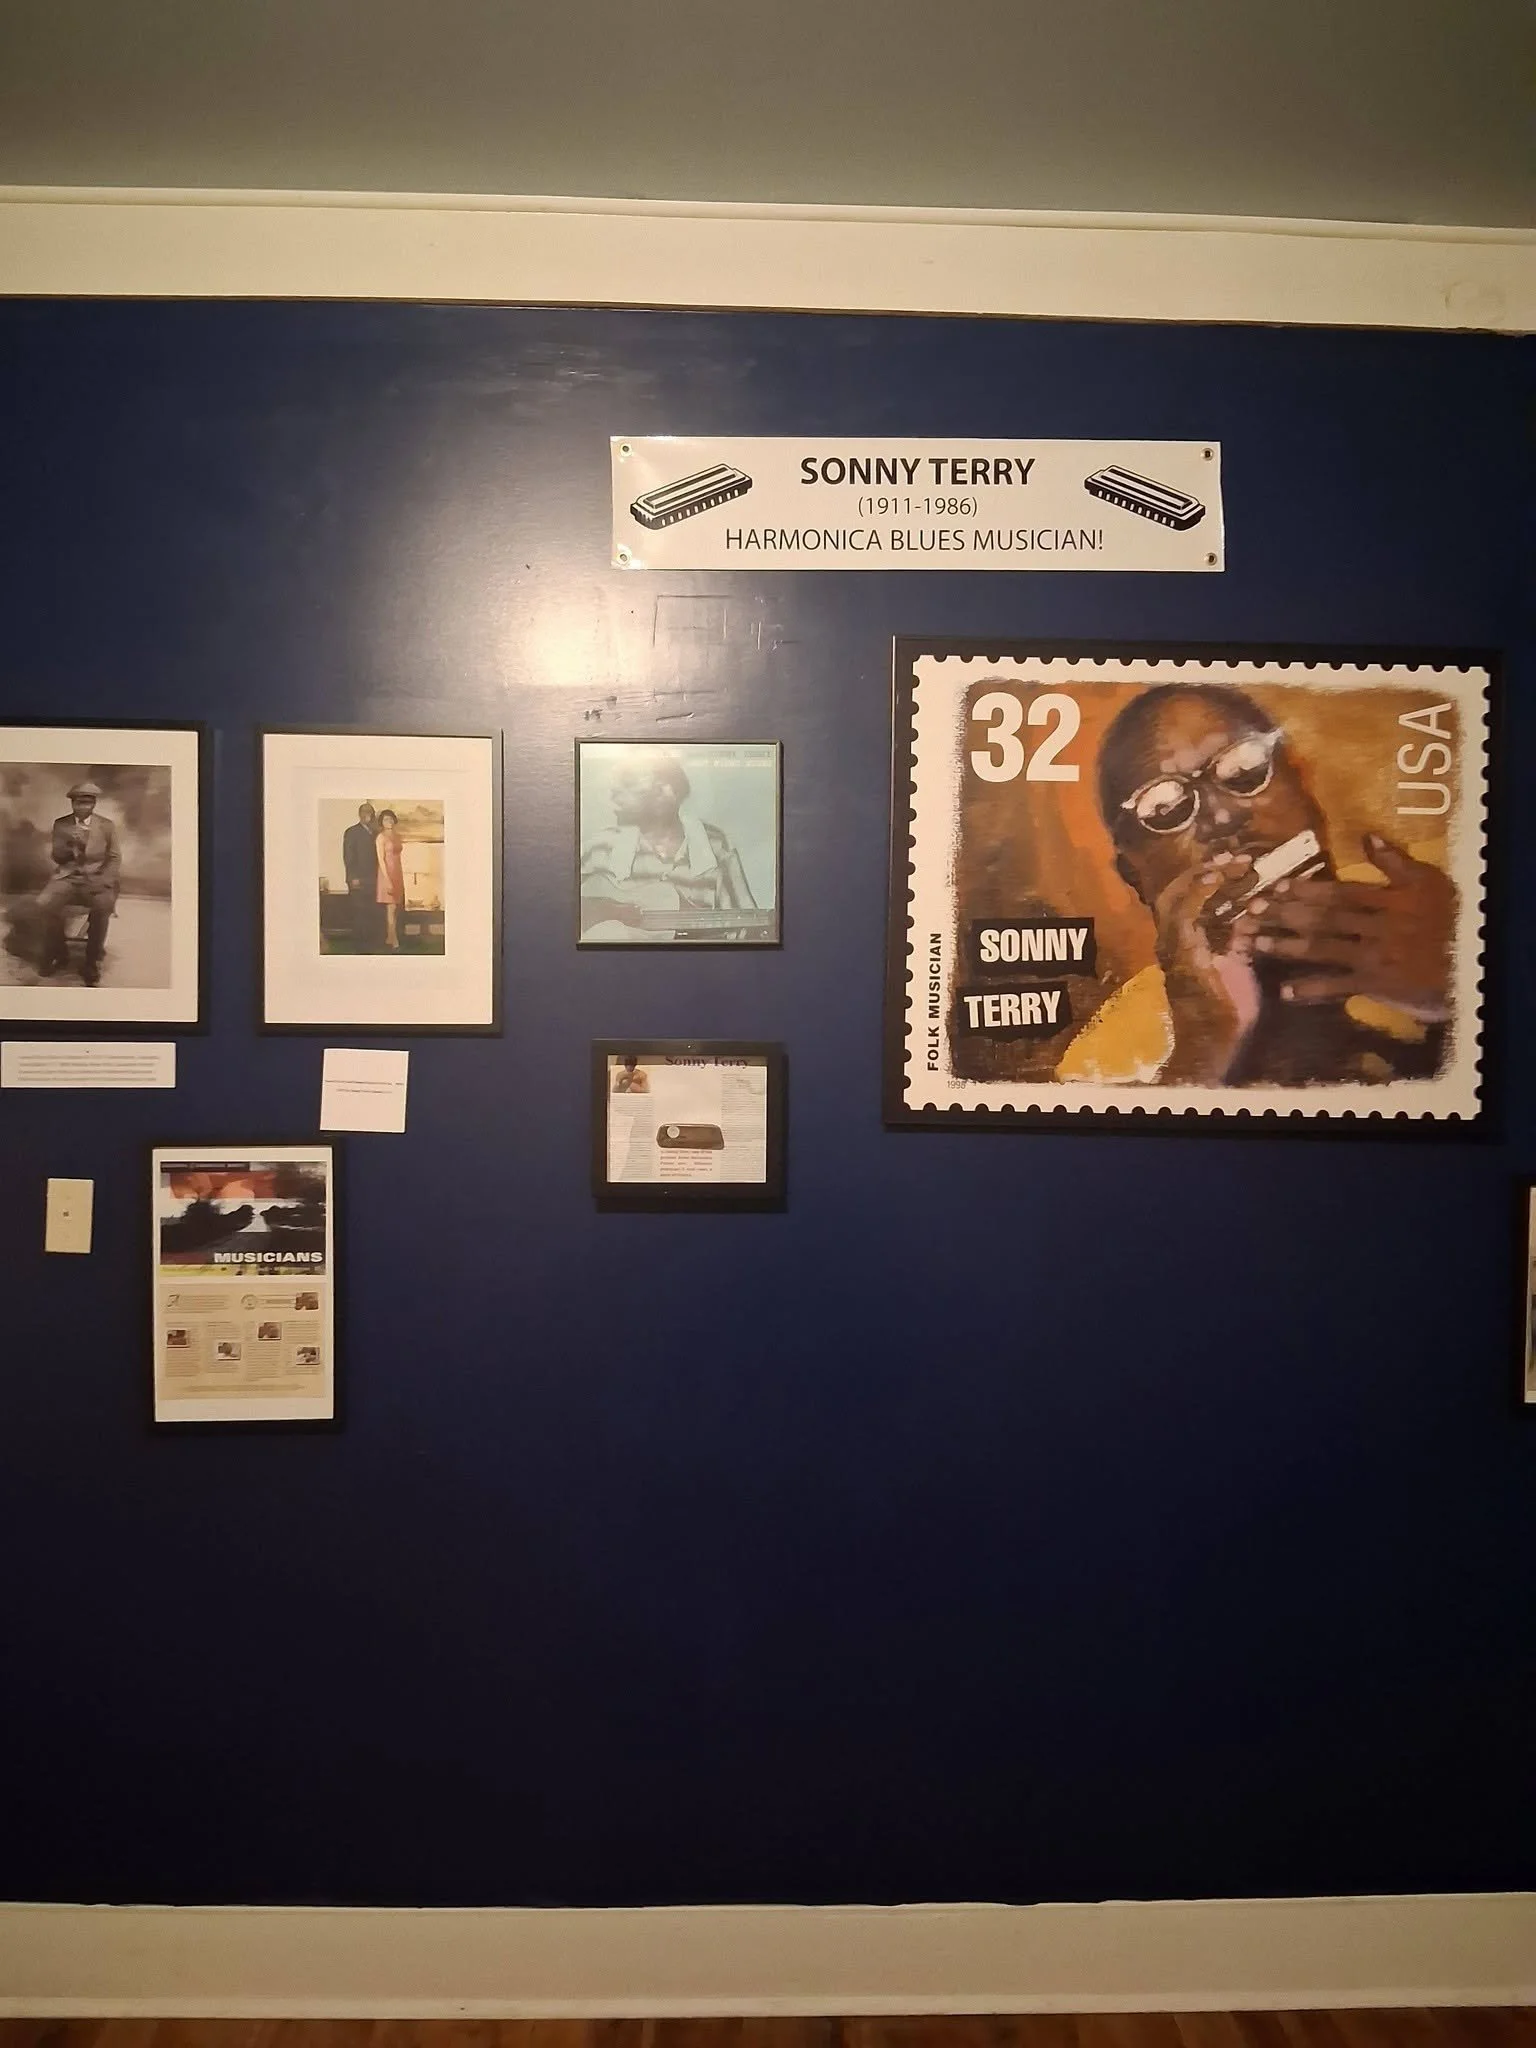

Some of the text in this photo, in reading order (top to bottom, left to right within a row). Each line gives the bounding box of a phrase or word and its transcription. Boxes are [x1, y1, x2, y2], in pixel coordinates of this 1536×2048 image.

[800, 458, 1036, 486] SONNY TERRY
[857, 498, 978, 517] (1911-1986)
[726, 528, 1104, 552] HARMONICA BLUES MUSICIAN!
[970, 692, 1081, 783] 32
[1397, 703, 1453, 817] USA
[980, 928, 1088, 963] SONNY
[927, 933, 942, 1072] FOLK MUSICIAN
[963, 990, 1061, 1029] TERRY
[665, 1056, 707, 1069] Sonny
[213, 1252, 323, 1263] MUSICIANS
